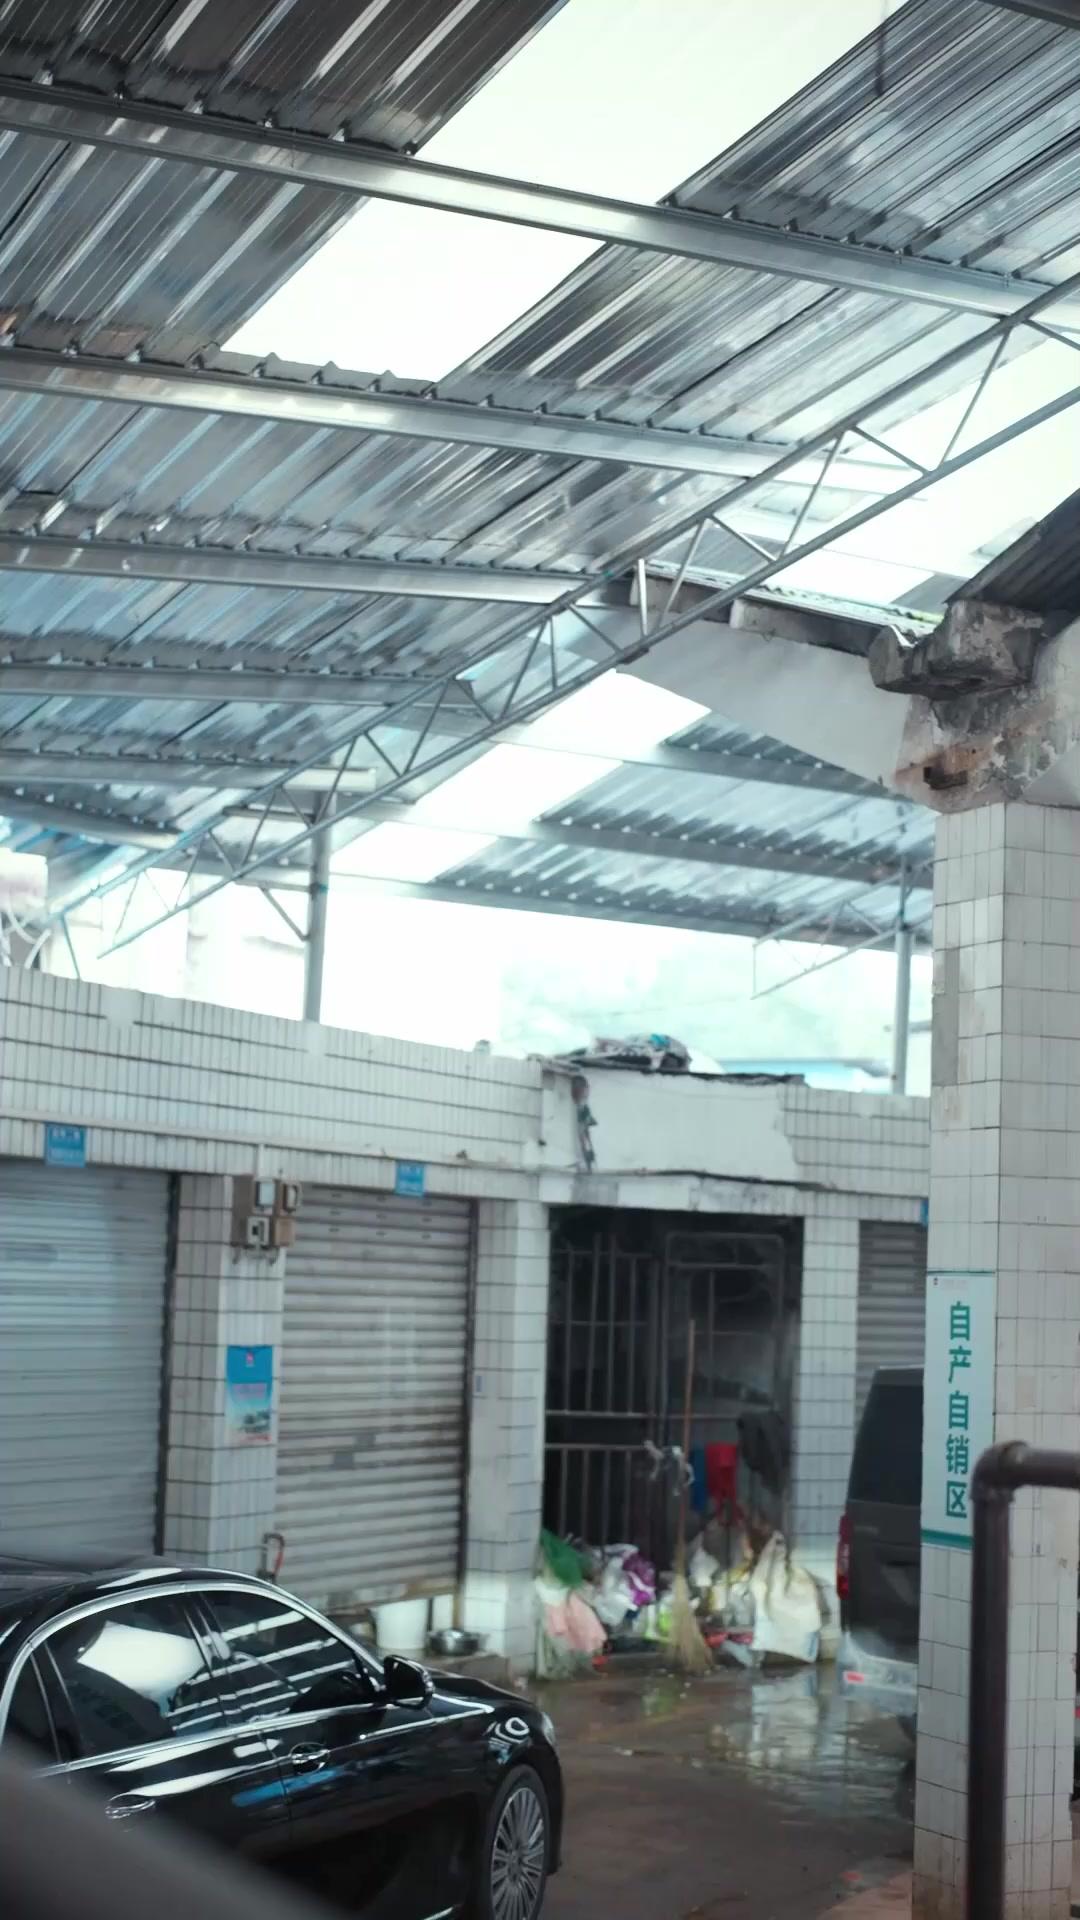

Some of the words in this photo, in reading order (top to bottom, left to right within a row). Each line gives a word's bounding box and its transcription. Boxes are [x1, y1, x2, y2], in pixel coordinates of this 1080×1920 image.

[946, 1301, 972, 1518] 自产自销区
